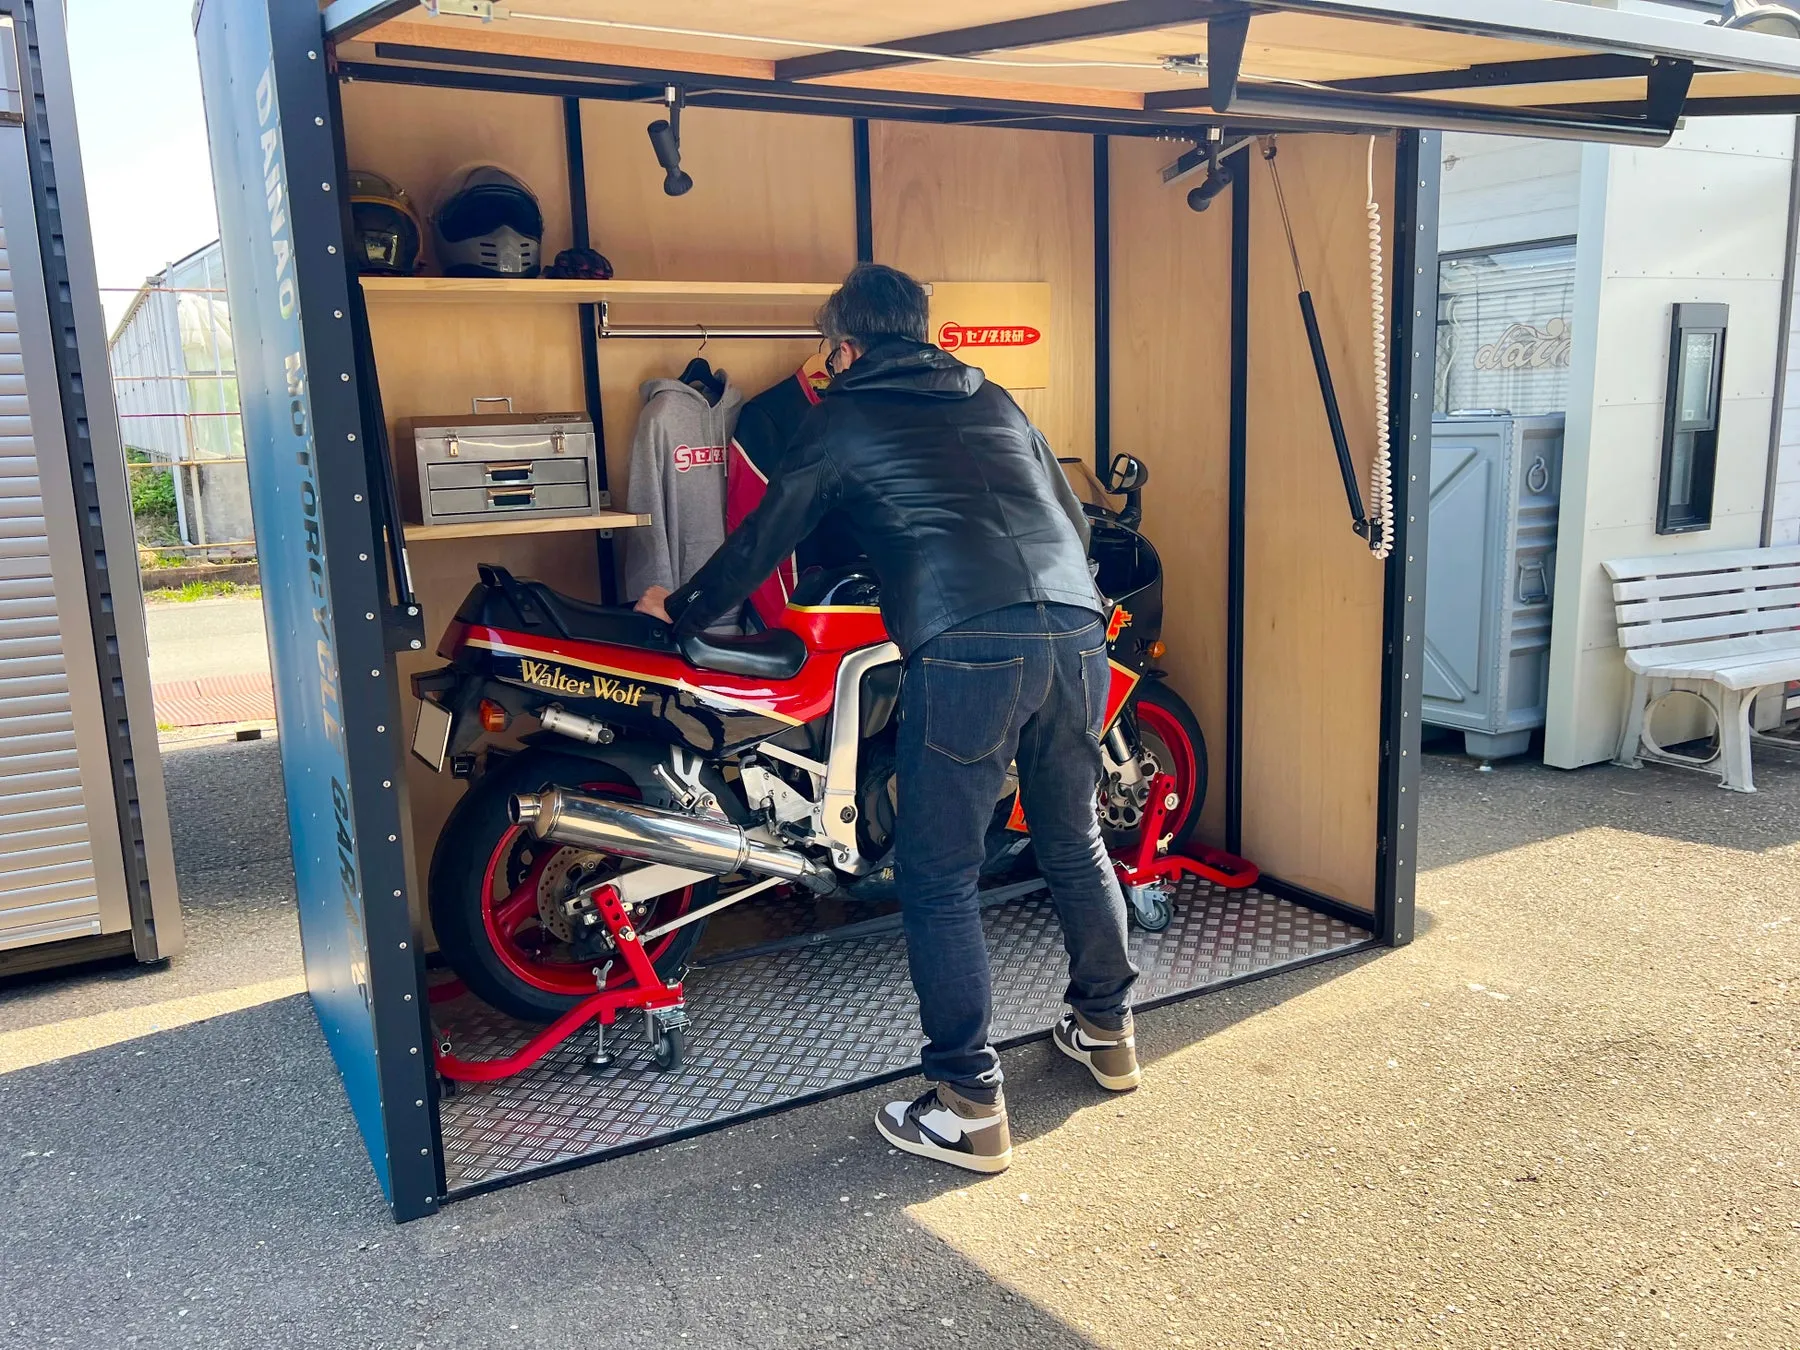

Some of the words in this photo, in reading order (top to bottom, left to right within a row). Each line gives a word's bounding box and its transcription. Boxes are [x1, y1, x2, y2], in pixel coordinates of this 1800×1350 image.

[256, 66, 295, 320] DAINAO
[285, 352, 342, 756] MOTORCYCLE
[520, 658, 591, 695] Walter
[592, 674, 646, 707] Wolf
